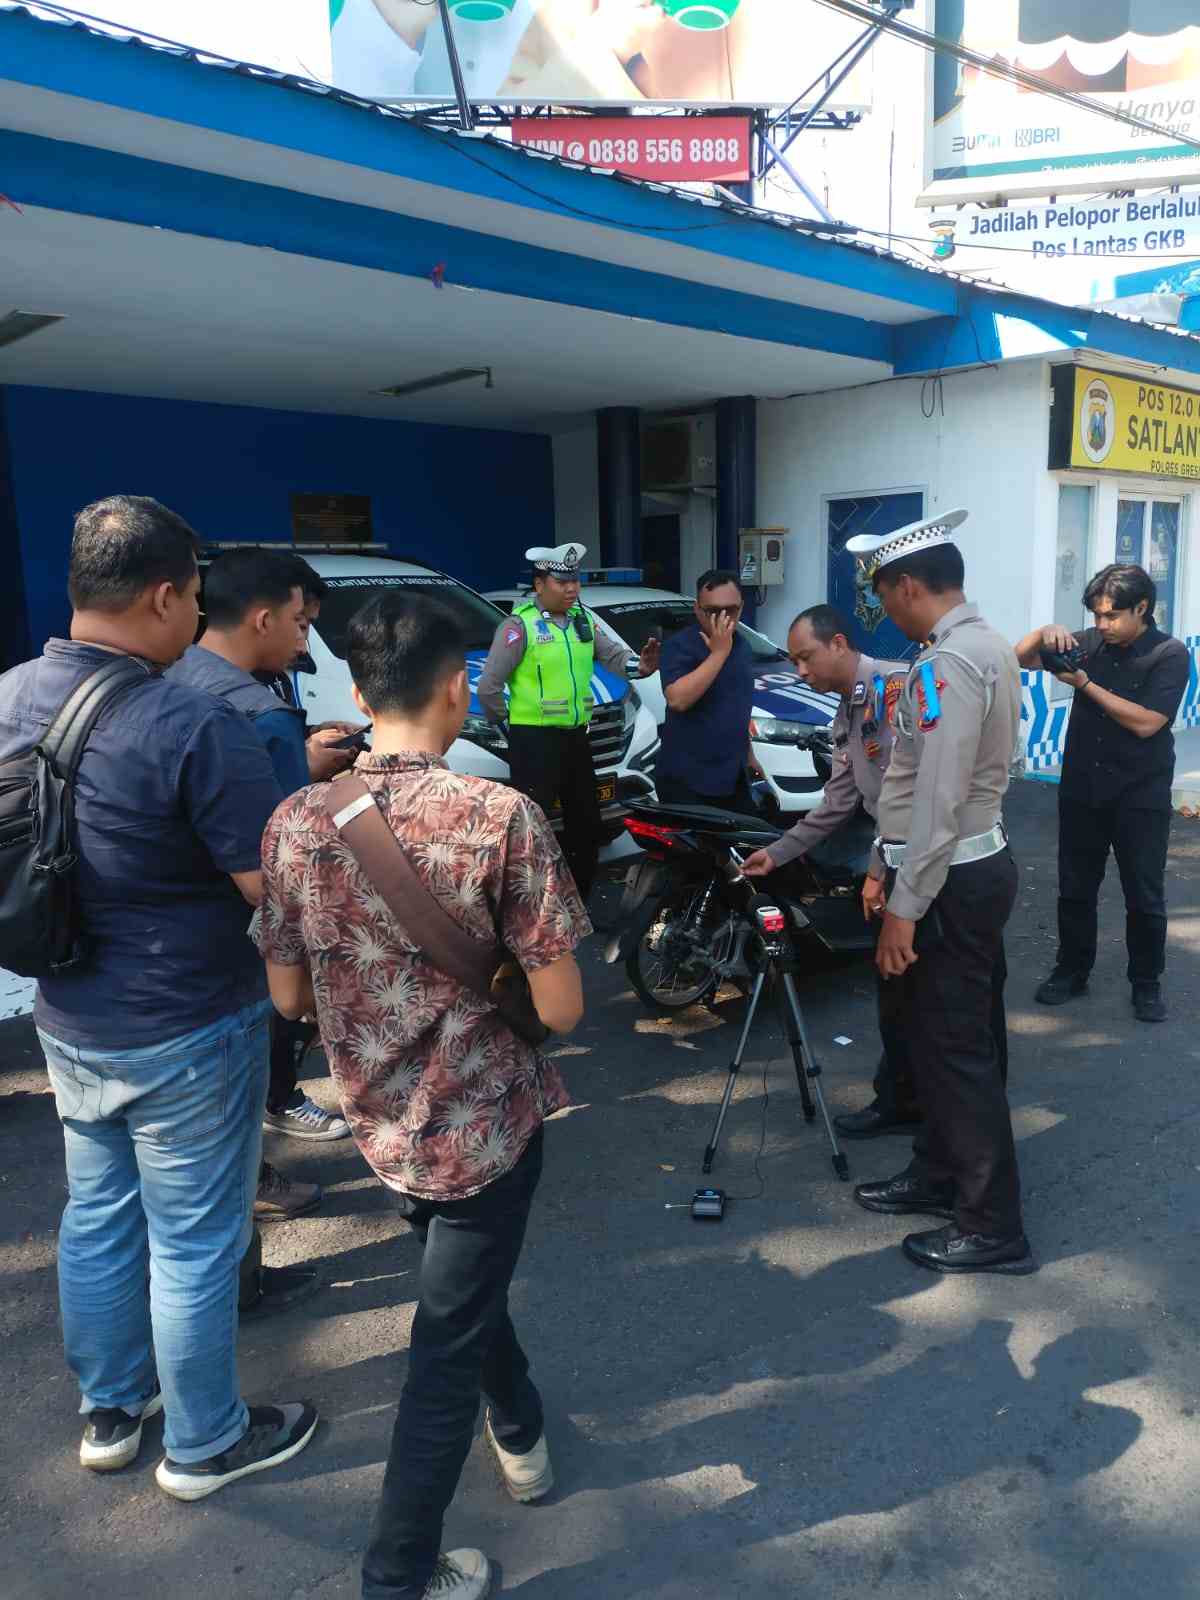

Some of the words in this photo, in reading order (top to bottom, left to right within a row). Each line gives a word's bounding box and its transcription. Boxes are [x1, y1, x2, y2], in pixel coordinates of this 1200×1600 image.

[588, 138, 639, 163] 0838
[645, 138, 683, 163] 556
[689, 138, 739, 162] 8888
[1033, 127, 1060, 145] BRI
[970, 209, 1038, 235] Jadilah
[1045, 205, 1121, 230] Pelopor
[1032, 240, 1066, 259] Pos
[1073, 235, 1137, 256] Lantas
[1143, 229, 1185, 250] GKB
[1138, 385, 1164, 411] POS
[1169, 393, 1193, 417] 12.0
